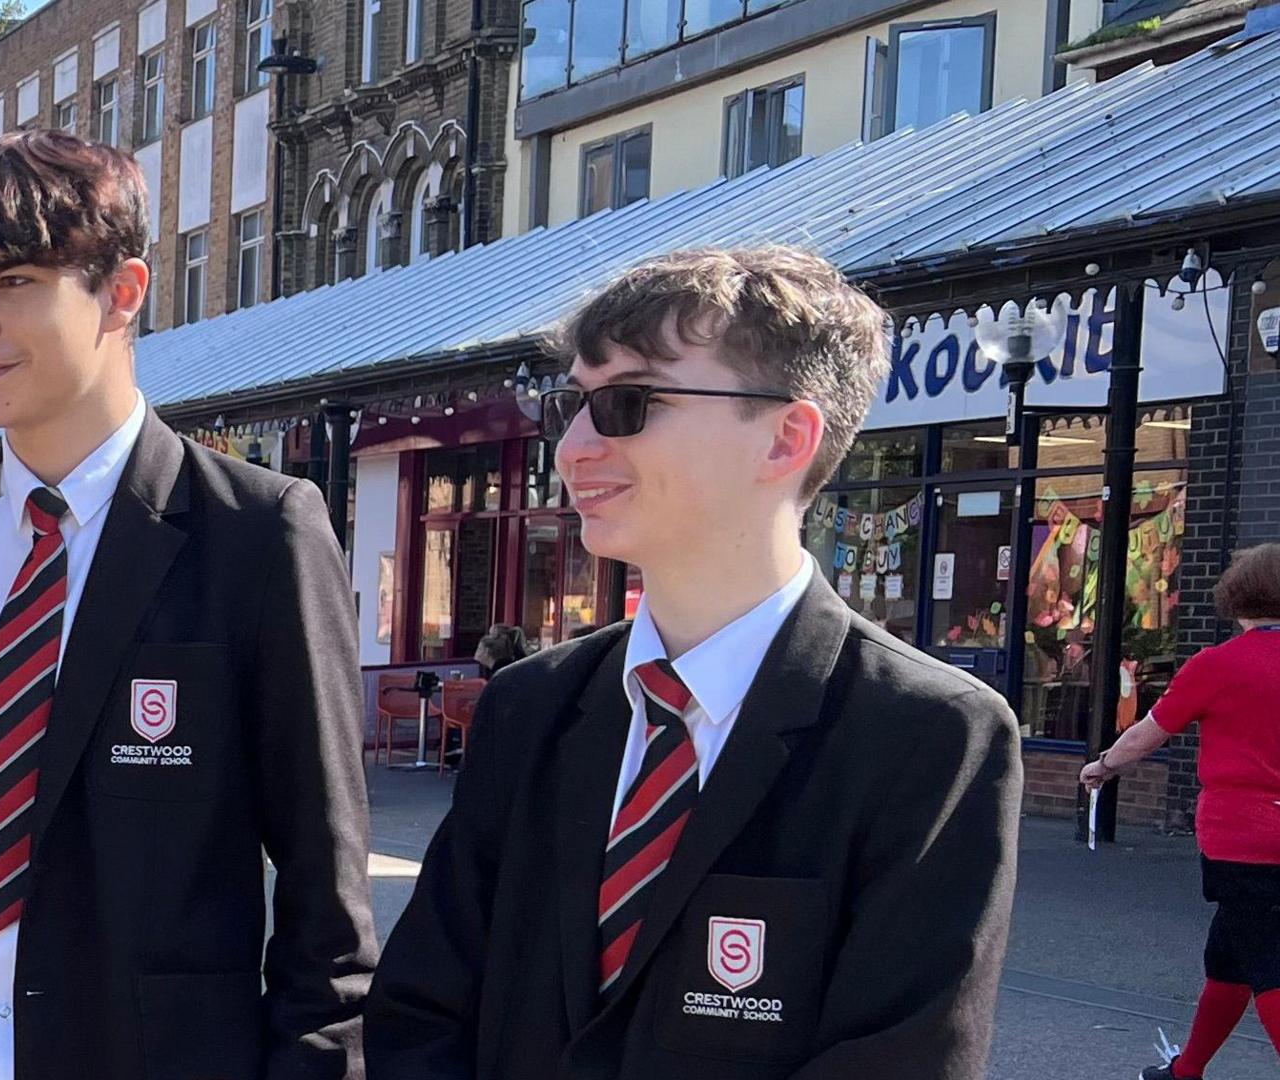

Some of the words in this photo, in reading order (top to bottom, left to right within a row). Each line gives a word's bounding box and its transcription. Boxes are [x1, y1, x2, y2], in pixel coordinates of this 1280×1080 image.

[816, 498, 856, 534] LAST
[862, 494, 925, 537] CHANC
[836, 545, 855, 567] TO
[865, 546, 900, 568] BUY
[111, 745, 192, 757] CRESTWOOD
[110, 756, 158, 765] COMMUNITY
[160, 757, 192, 765] SCHOOL
[684, 992, 783, 1011] CRESTWOOD
[682, 1005, 740, 1019] COMMUNITY
[743, 1011, 783, 1022] SCHOOL
